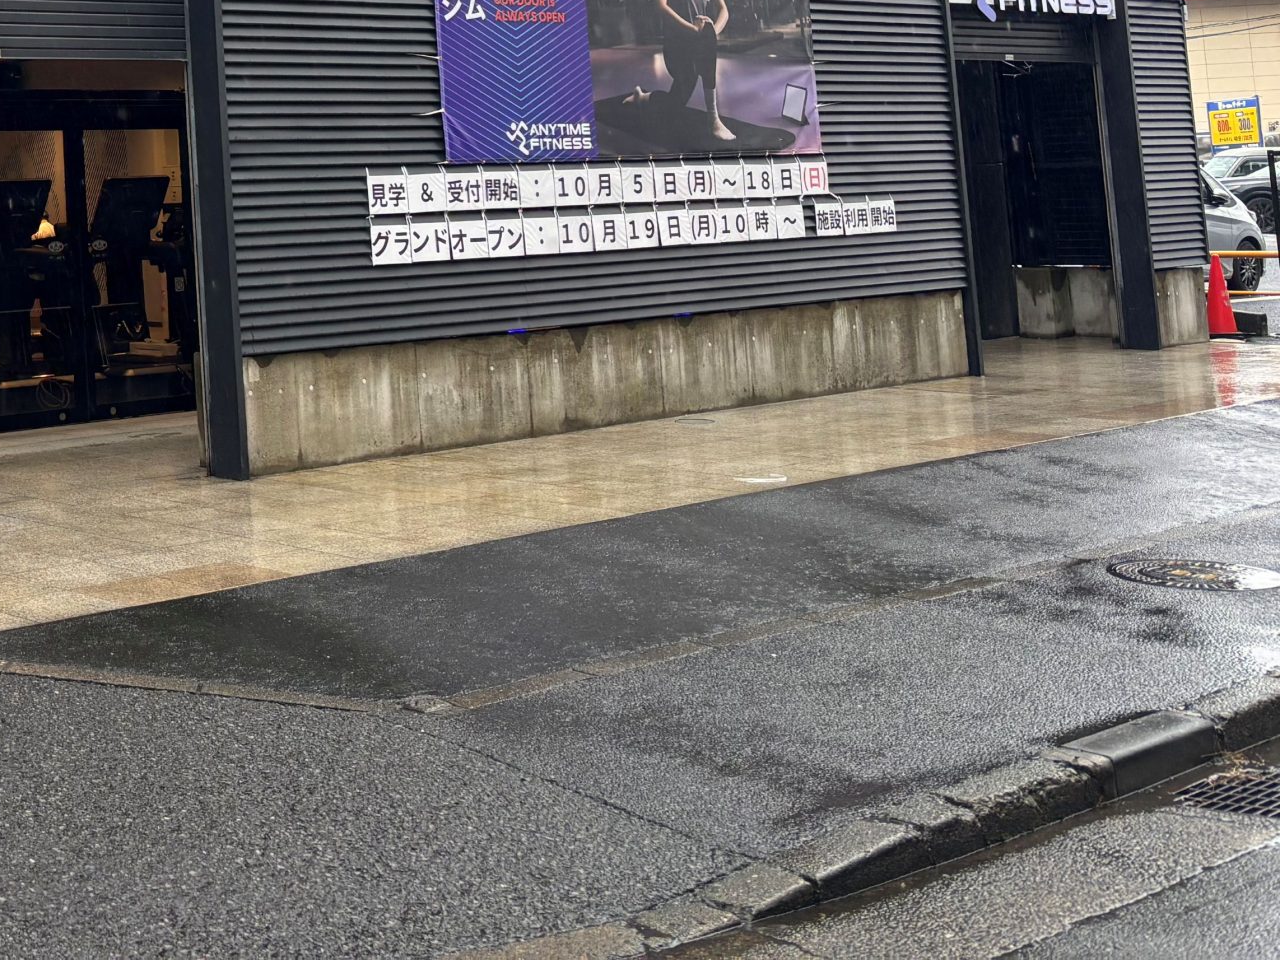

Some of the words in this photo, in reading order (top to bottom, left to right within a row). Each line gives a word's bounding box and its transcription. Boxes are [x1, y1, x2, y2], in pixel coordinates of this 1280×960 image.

[495, 11, 538, 22] ALWAYS
[538, 12, 566, 23] OPEN
[529, 123, 592, 136] ANYTIME
[529, 137, 593, 151] FITNESS
[816, 204, 896, 231] 施設利用開始
